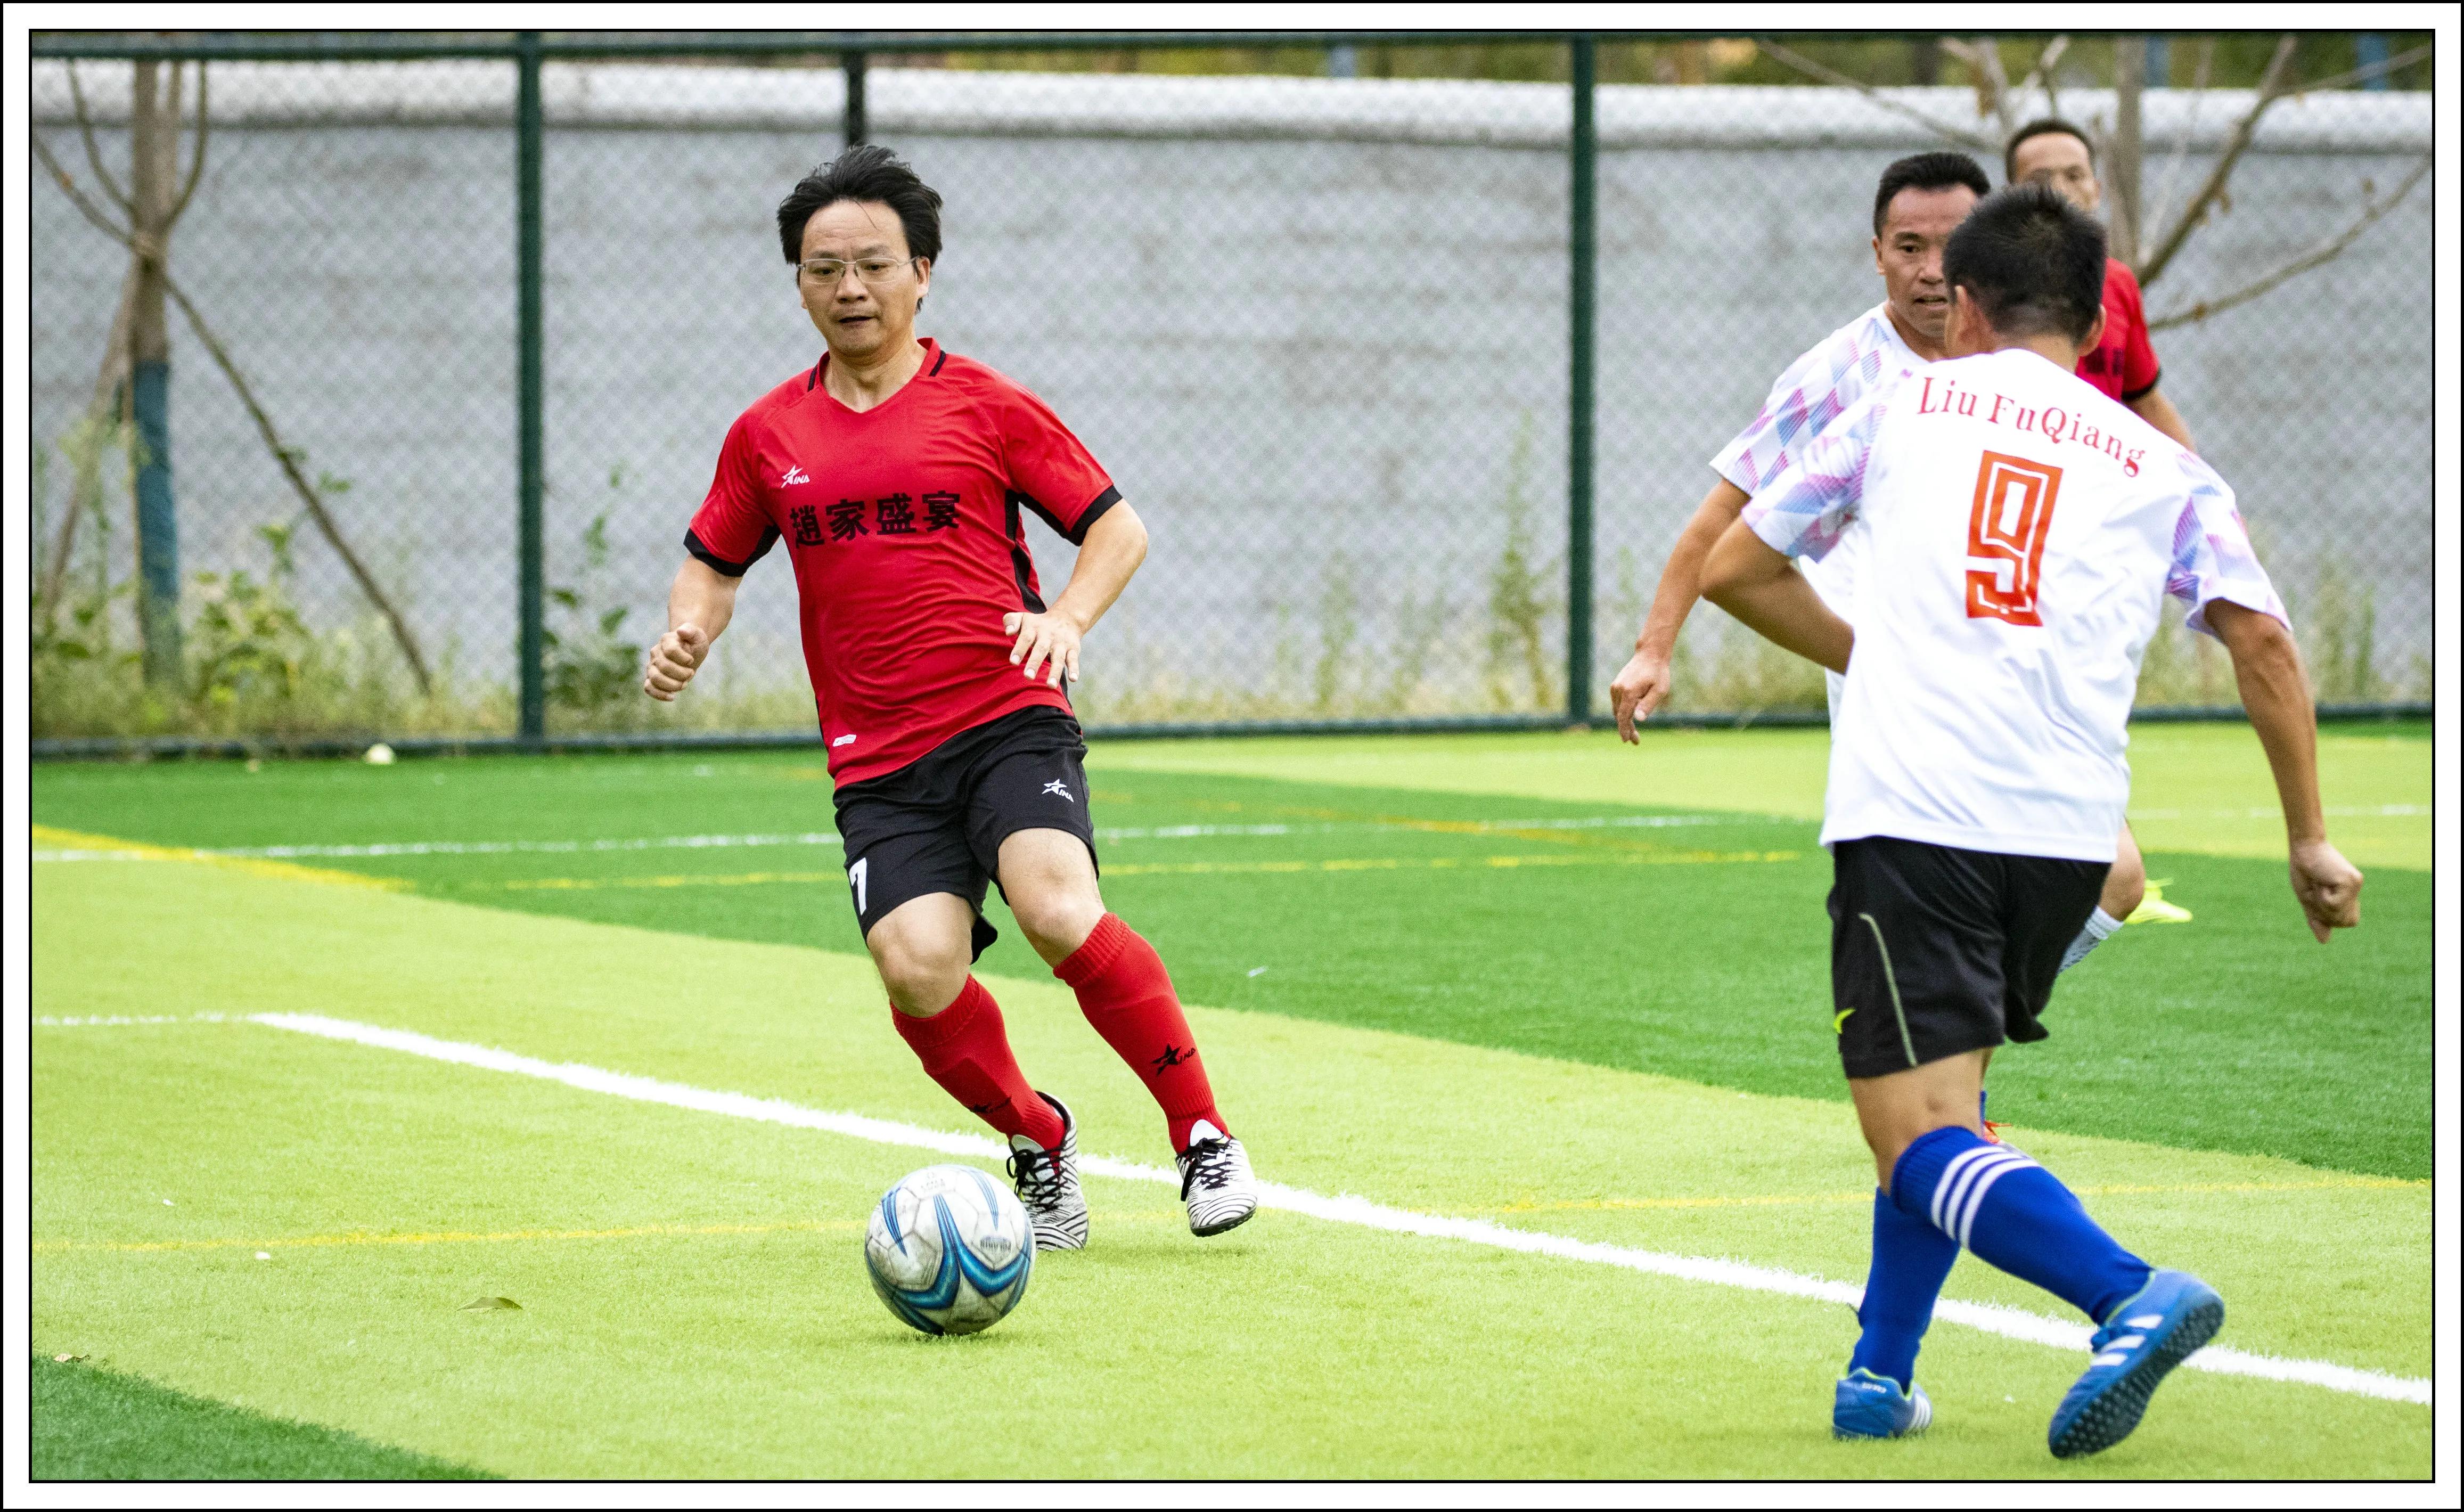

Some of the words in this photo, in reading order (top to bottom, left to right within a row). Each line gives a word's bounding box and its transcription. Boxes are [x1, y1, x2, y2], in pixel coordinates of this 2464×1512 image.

[1917, 377, 1977, 416] Liu
[1987, 393, 2146, 478] FuQiang
[1964, 449, 2064, 627] 9
[849, 857, 867, 916] 7
